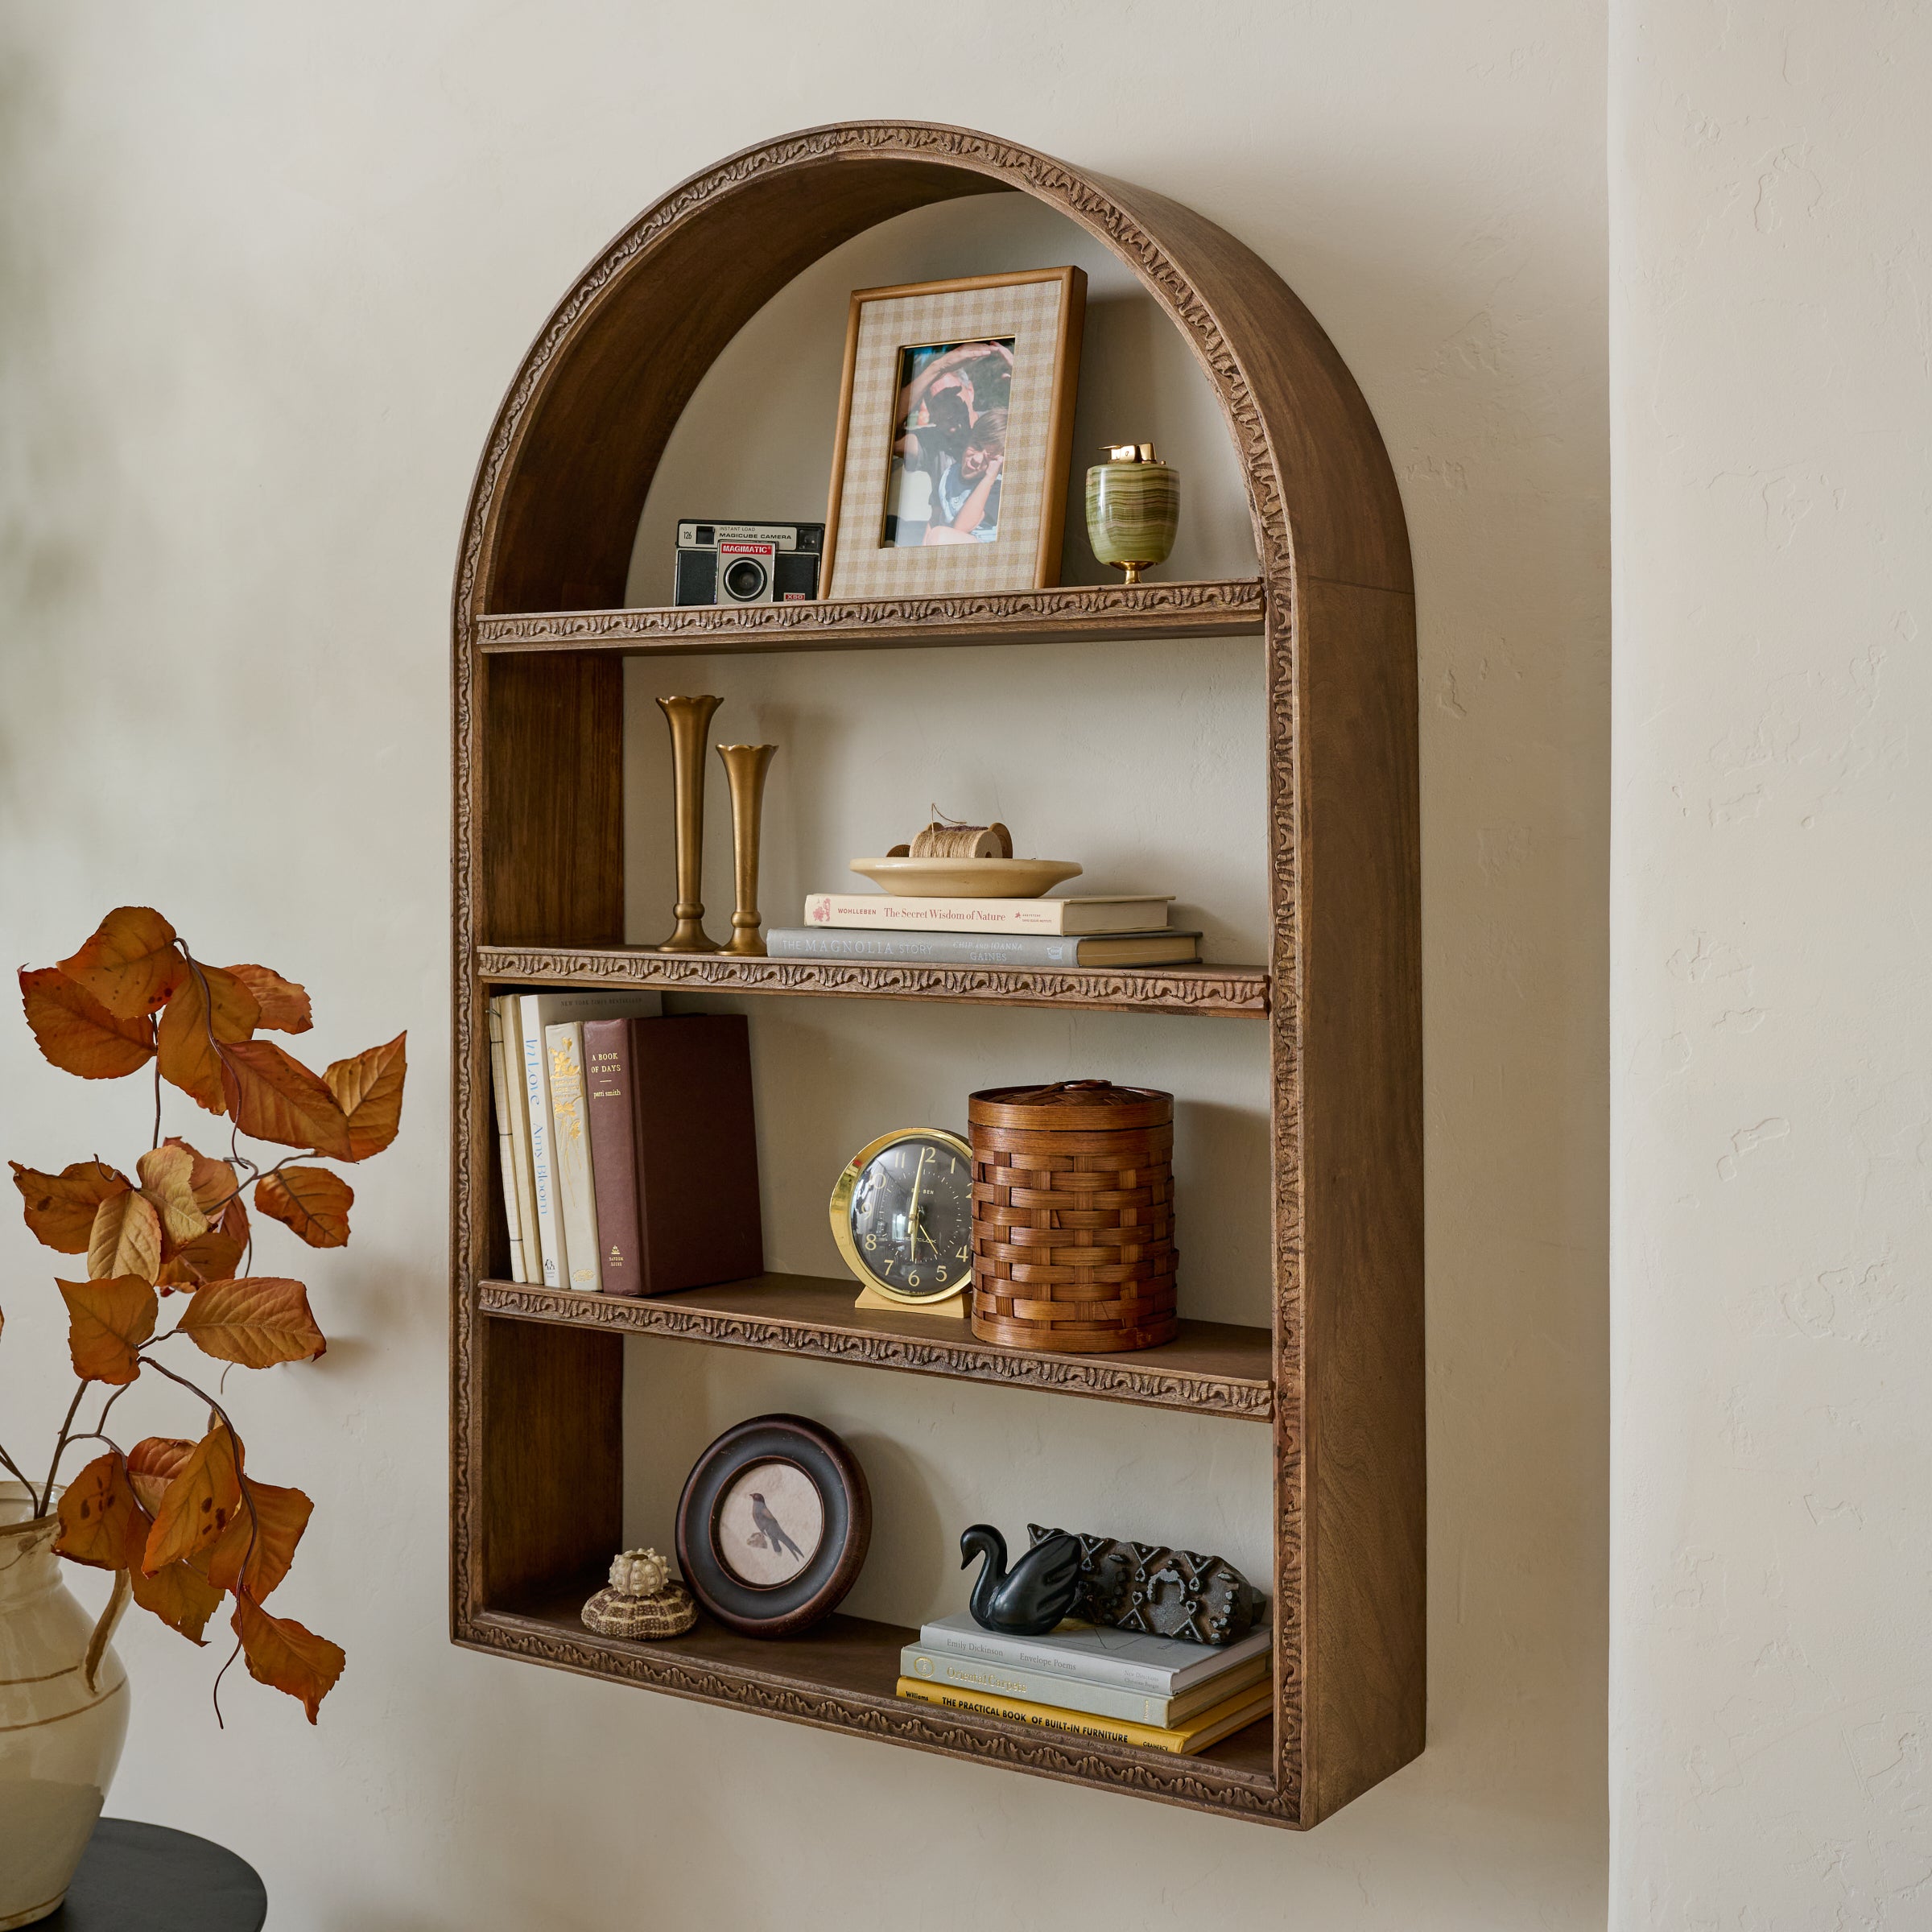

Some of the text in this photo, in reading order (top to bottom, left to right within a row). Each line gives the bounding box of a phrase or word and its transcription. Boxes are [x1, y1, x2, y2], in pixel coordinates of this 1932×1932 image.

[683, 531, 692, 539] 126
[723, 545, 768, 553] MAGIMATIC
[884, 907, 901, 918] The
[901, 908, 927, 919] Secret
[929, 909, 964, 920] Wisdom
[966, 910, 976, 920] of
[976, 910, 1005, 921] Nature
[782, 939, 932, 955] THE MAGNOLIA STORY
[990, 942, 1022, 951] JOANNA
[970, 952, 1006, 961] GAINES
[598, 1052, 618, 1061] BOOK
[601, 1064, 621, 1072] DAYS
[593, 1090, 605, 1100] patti
[526, 1039, 548, 1215] In Love Amy Bloom
[950, 1157, 956, 1174] 1
[861, 1202, 872, 1220] 9
[865, 1233, 877, 1250] 8
[956, 1245, 968, 1262] 4
[884, 1259, 894, 1276] 7
[935, 1265, 947, 1282] 5
[908, 1269, 920, 1286] 6
[947, 1638, 1076, 1670] Emily Dickinson Envelope Poems
[947, 1666, 1027, 1693] Oriental Carpets
[906, 1690, 929, 1701] Williams
[942, 1696, 956, 1707] THE
[959, 1700, 1000, 1716] PRACTICAL
[1002, 1710, 1026, 1722] BOOK
[1031, 1715, 1042, 1725] OF
[1045, 1718, 1080, 1733] BUILT-IN
[1082, 1727, 1129, 1743] FURNITURE
